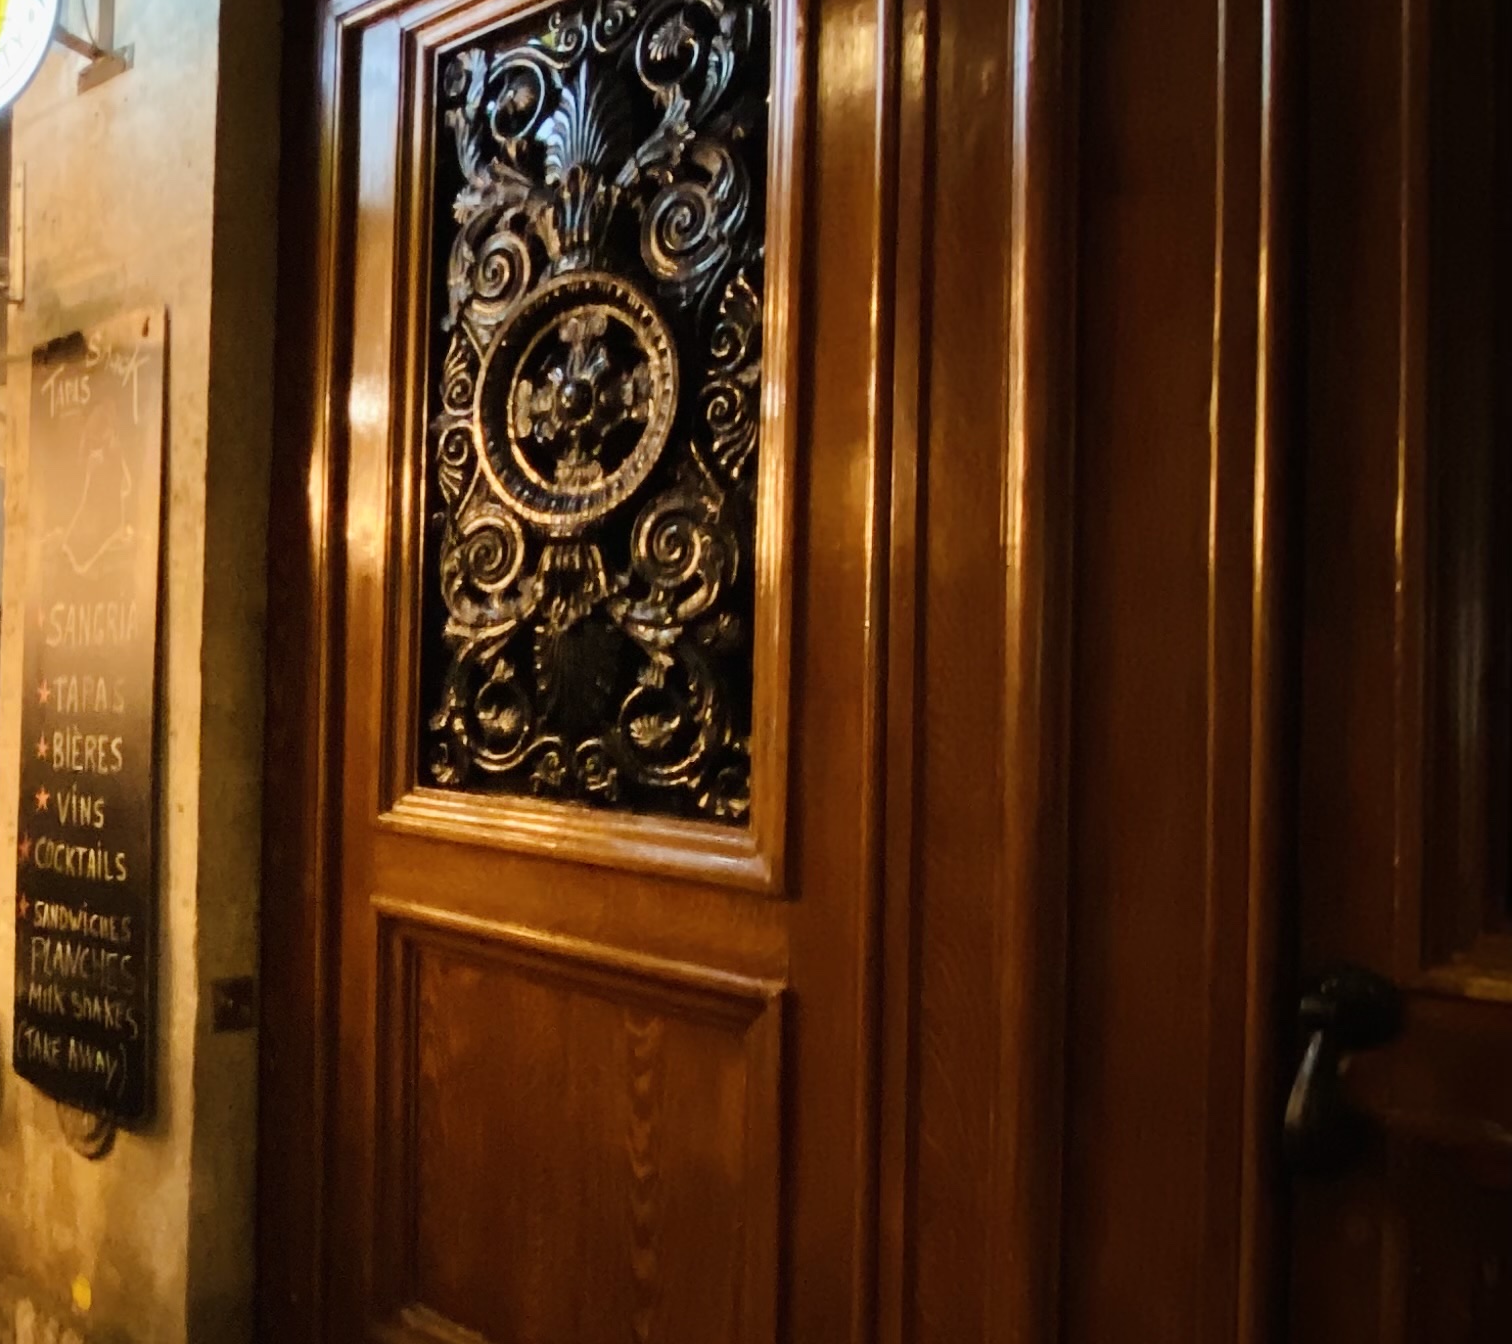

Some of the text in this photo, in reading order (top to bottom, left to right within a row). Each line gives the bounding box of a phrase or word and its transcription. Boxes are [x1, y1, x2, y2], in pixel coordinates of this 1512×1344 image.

[52, 674, 125, 715] TAPAS
[52, 724, 123, 775] BIÈRES
[34, 836, 127, 881] COCKTAILS
[30, 935, 138, 995] PLANCHES
